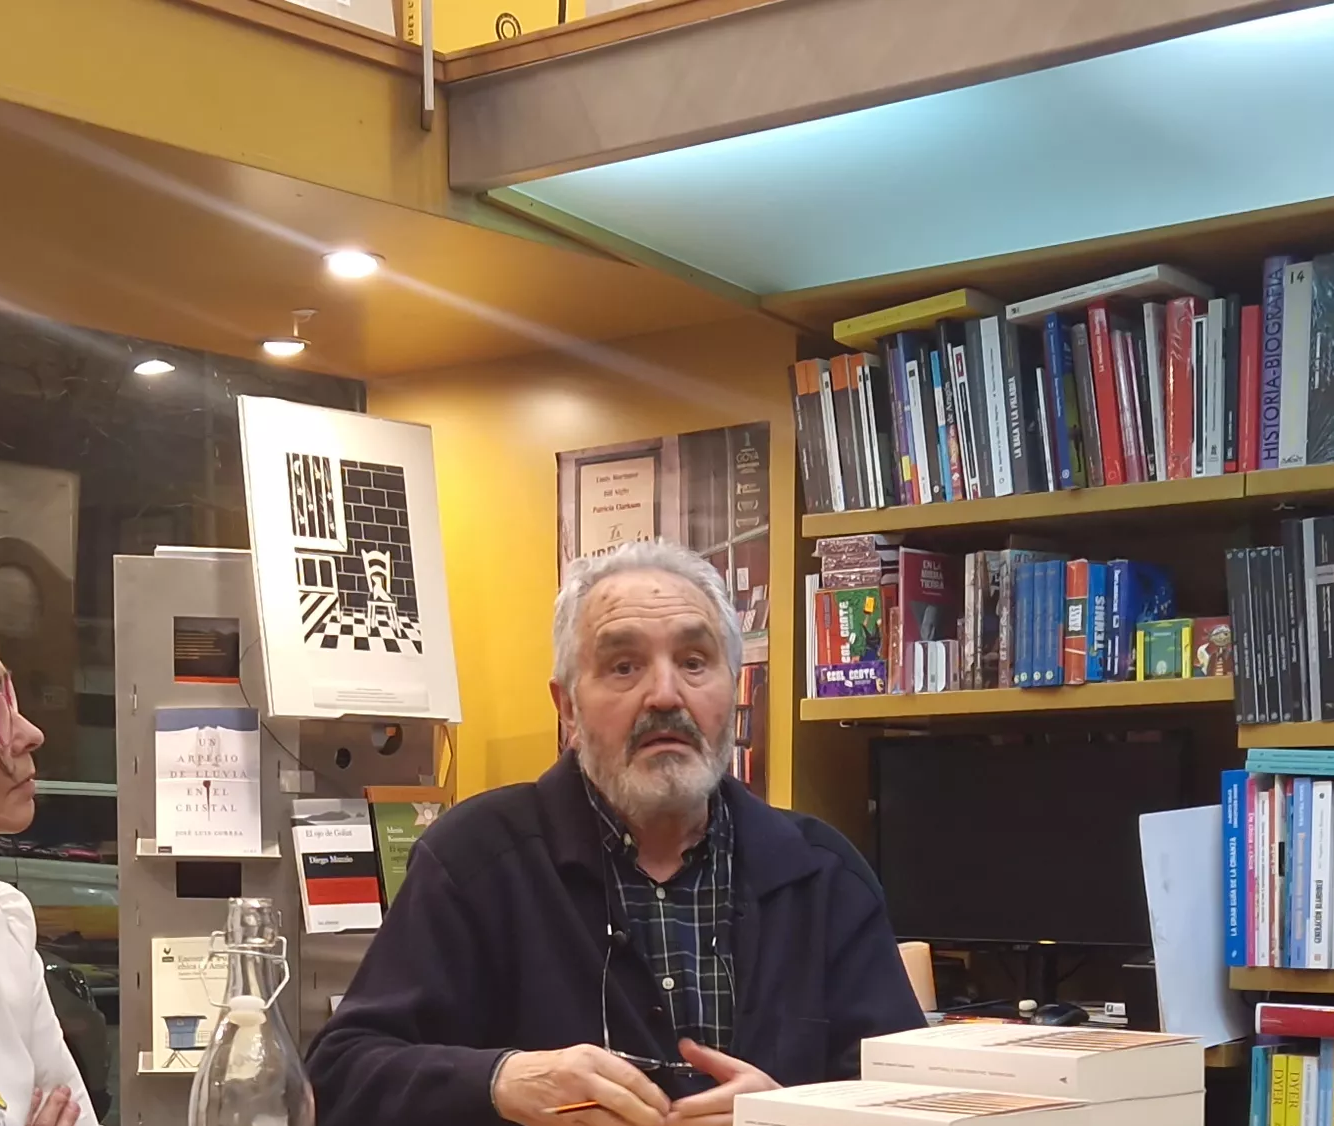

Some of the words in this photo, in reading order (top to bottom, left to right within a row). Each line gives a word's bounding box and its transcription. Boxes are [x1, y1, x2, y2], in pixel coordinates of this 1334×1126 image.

[1094, 595, 1105, 651] TENNIS
[198, 738, 217, 747] UN
[177, 754, 239, 763] ARPEGIO
[169, 770, 187, 778] DE
[195, 770, 248, 778] LLUVIA
[187, 788, 203, 796] EN
[213, 788, 230, 796] EL
[175, 803, 238, 812] CRISTAL
[1228, 836, 1237, 867] CRIANZA
[1229, 868, 1238, 877] LA
[1229, 879, 1238, 888] DE
[1229, 907, 1238, 926] GRAN
[1230, 927, 1238, 937] LA
[1272, 1068, 1285, 1105] DYER
[1288, 1071, 1301, 1109] DYER
